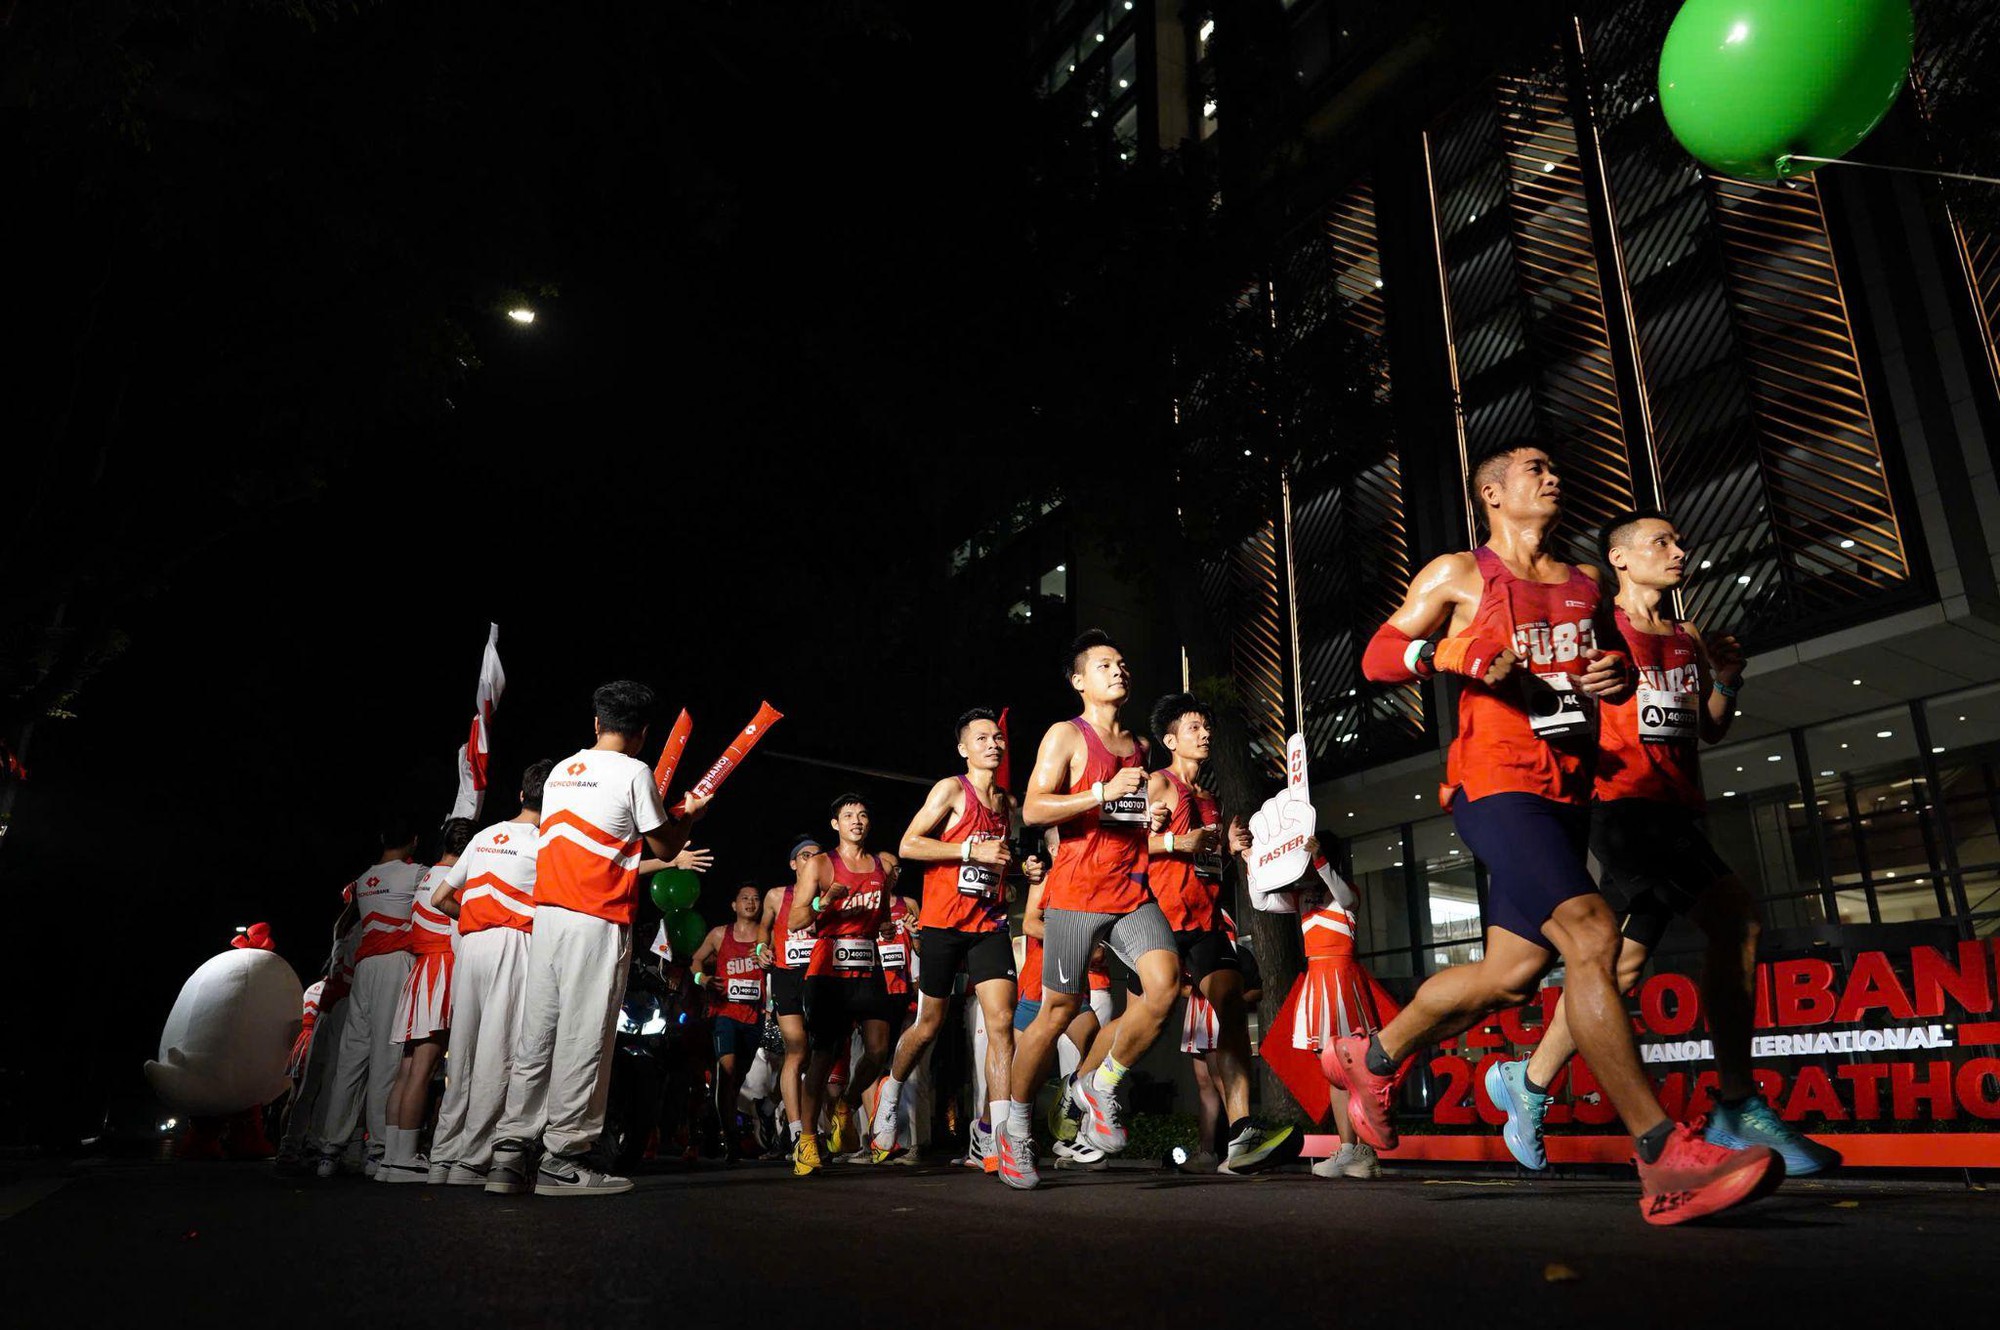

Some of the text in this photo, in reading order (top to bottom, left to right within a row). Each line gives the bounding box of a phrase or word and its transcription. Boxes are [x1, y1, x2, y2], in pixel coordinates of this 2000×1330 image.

[1645, 708, 1661, 723] A
[1291, 749, 1303, 785] RUN
[1118, 800, 1145, 809] 400707
[1258, 833, 1304, 868] FASTER
[964, 869, 976, 881] A
[838, 950, 846, 959] B
[726, 957, 760, 976] SUB
